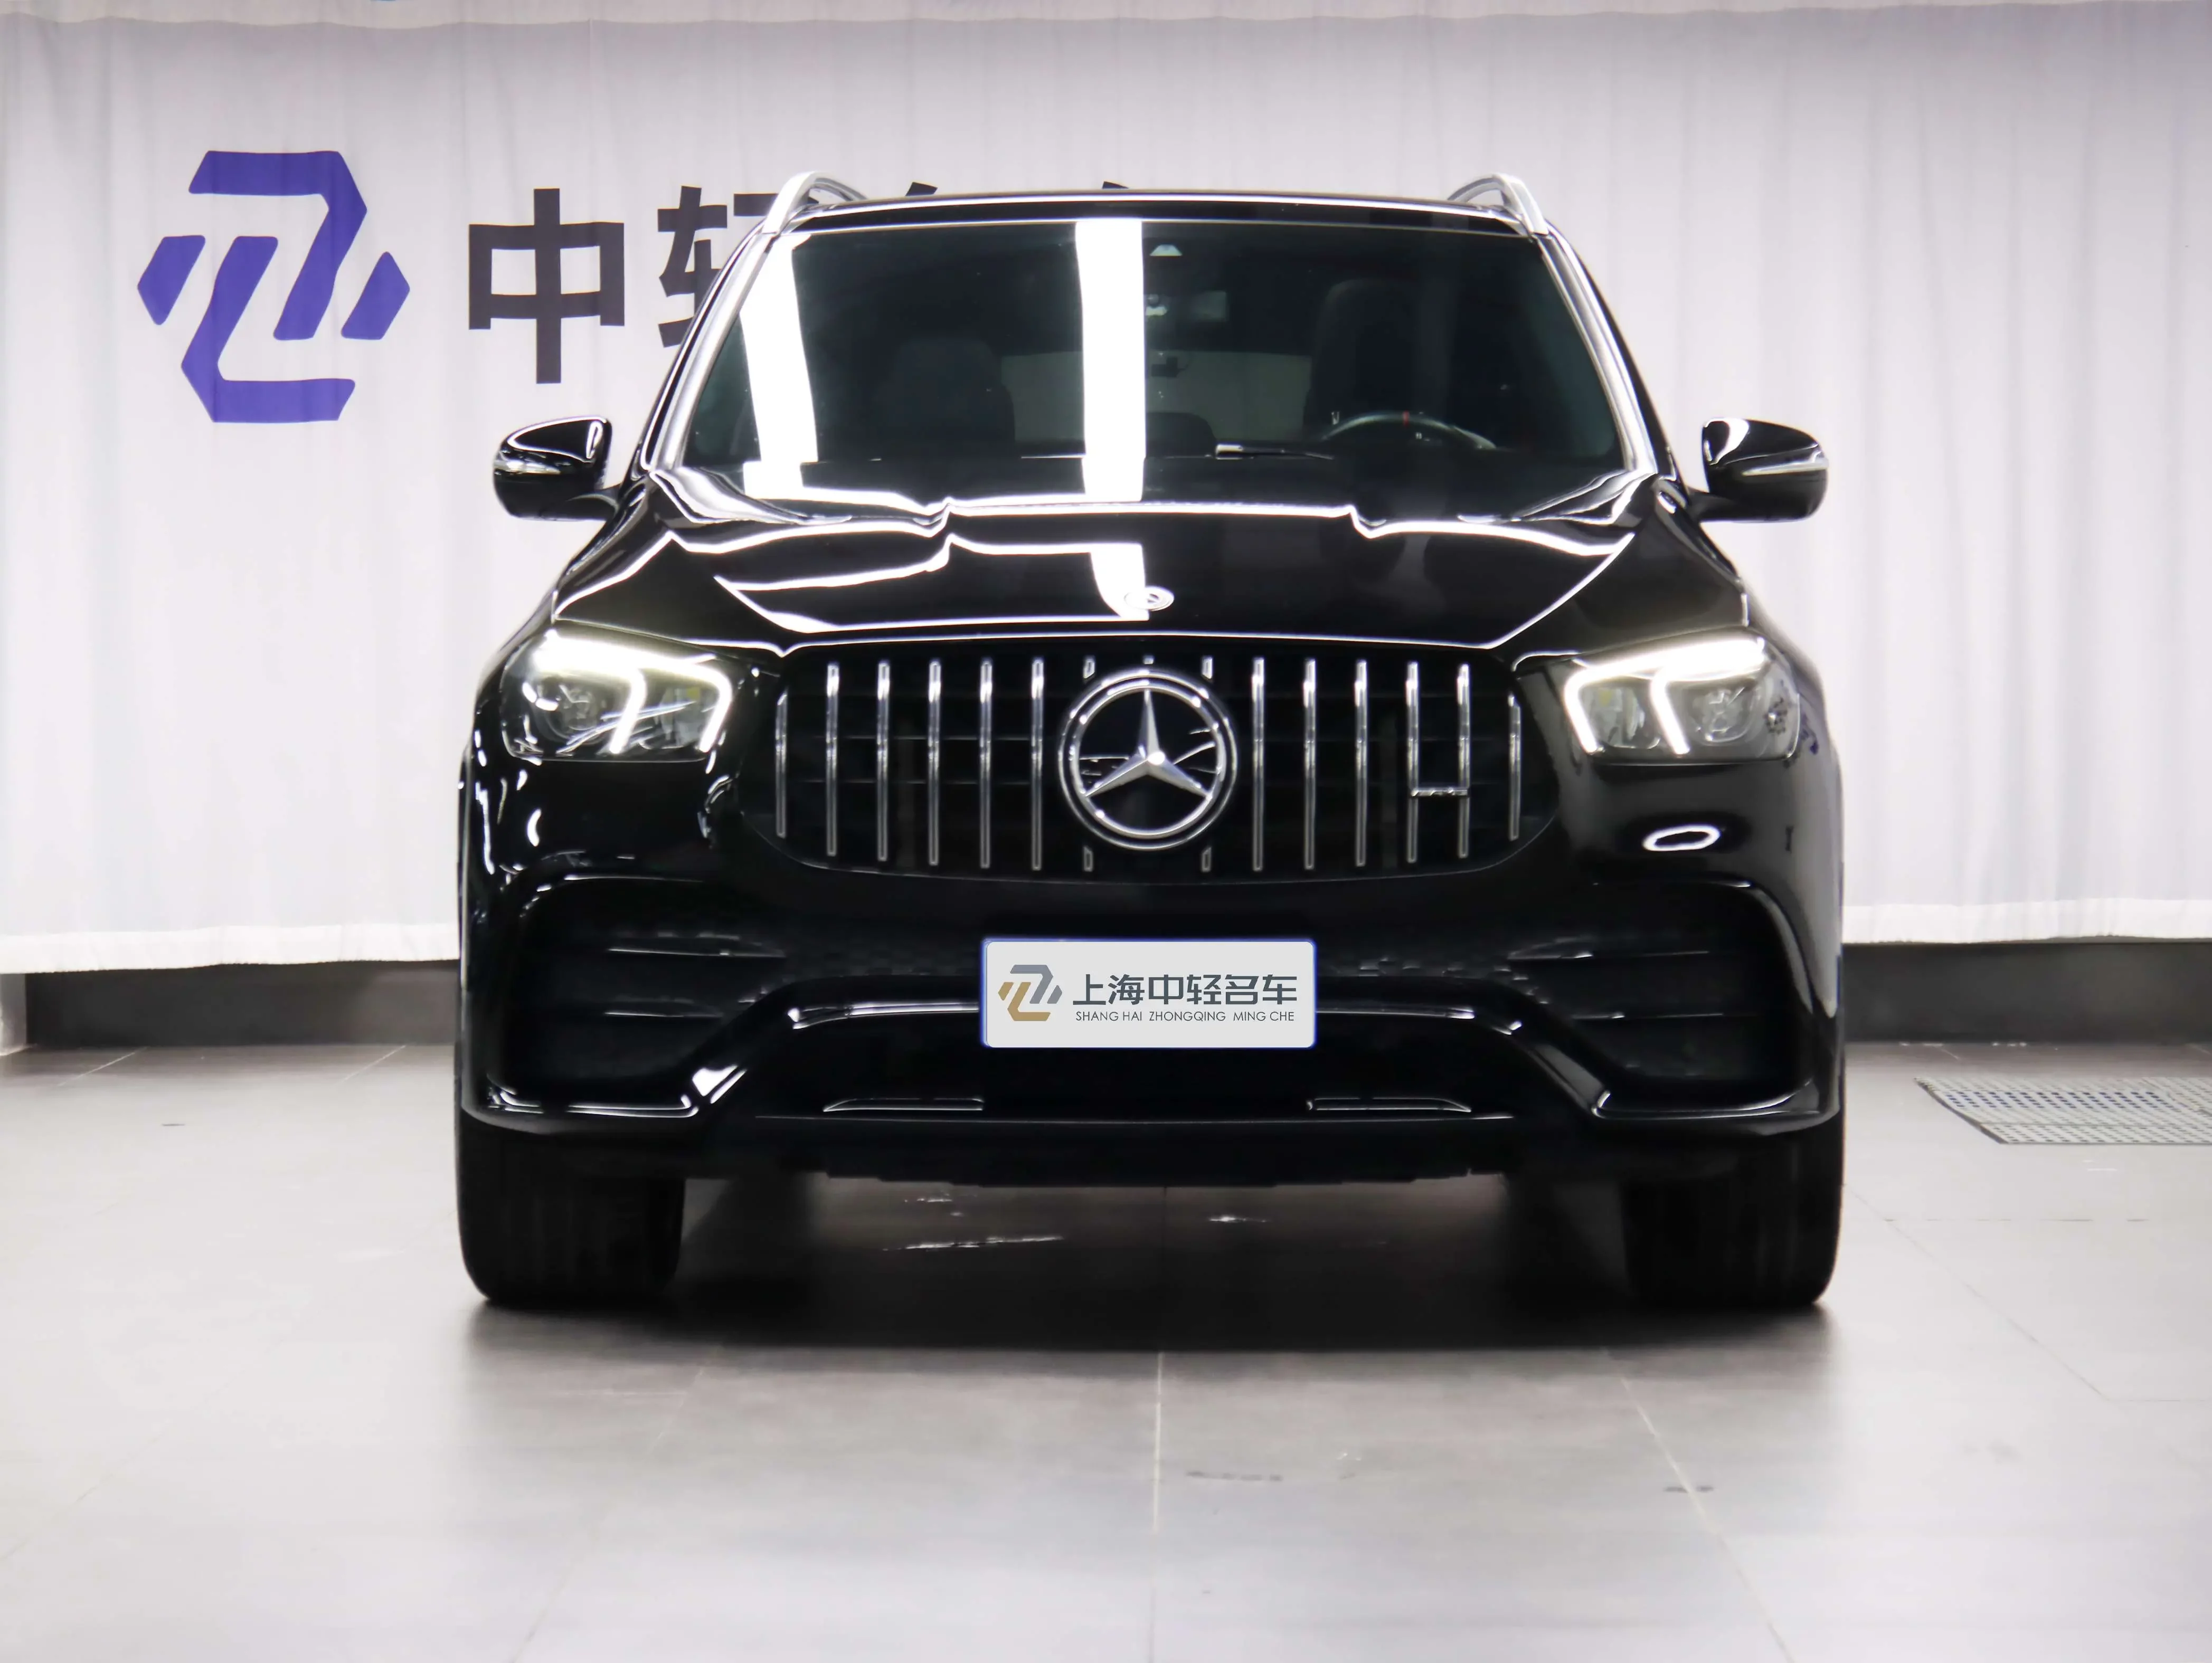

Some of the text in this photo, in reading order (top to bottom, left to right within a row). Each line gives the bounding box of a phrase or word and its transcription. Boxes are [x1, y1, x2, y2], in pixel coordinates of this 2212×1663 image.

[1073, 974, 1297, 1005] 上海中轻名车
[1075, 1011, 1295, 1022] SHANG HAI ZHONGQING MING CHE
